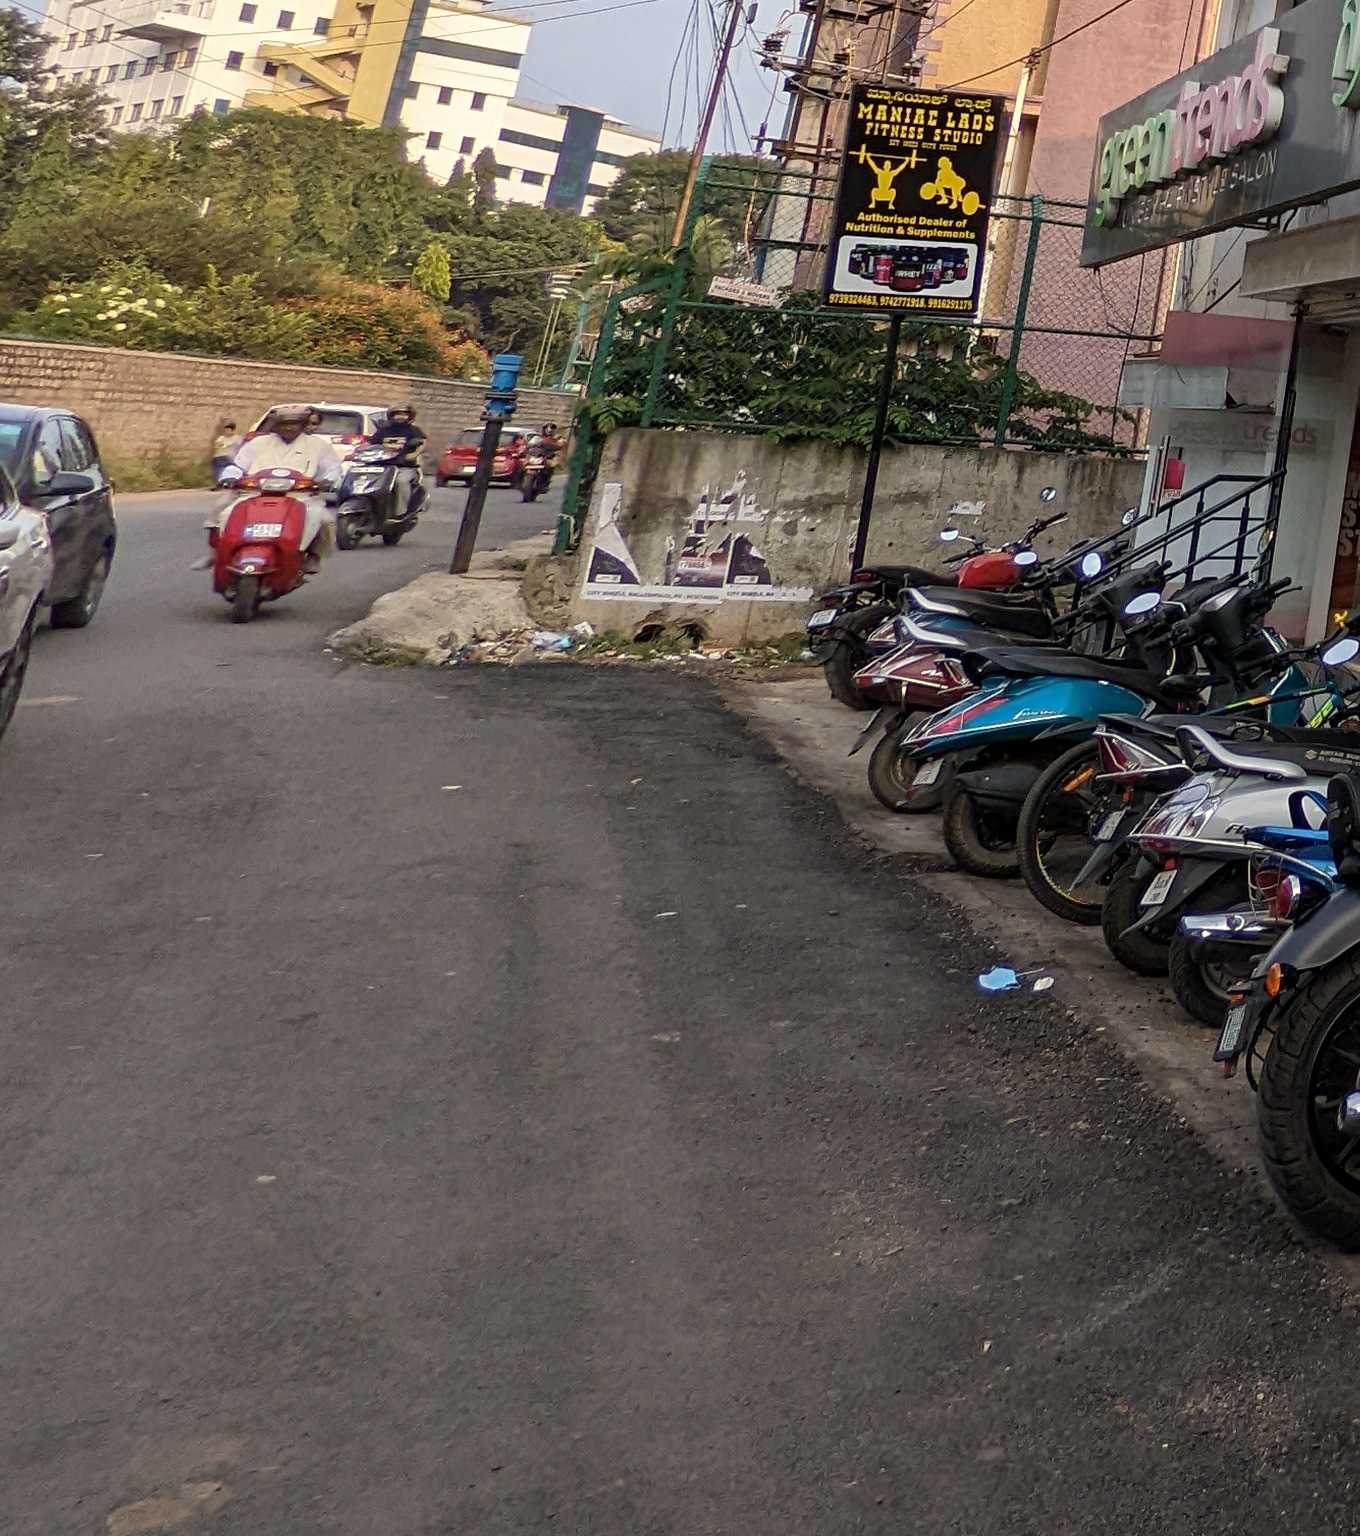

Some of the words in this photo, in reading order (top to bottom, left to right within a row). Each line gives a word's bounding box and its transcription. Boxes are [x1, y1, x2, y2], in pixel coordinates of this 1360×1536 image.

[857, 102, 939, 126] MANIAC
[945, 112, 995, 132] LADS
[864, 122, 924, 140] FITNESS
[933, 129, 983, 145] STUDIO
[857, 211, 916, 225] Authorised
[918, 216, 954, 228] Dealer
[956, 219, 968, 228] of
[845, 222, 894, 234] Nutrition
[895, 225, 905, 235] &
[907, 226, 975, 240] Supplements
